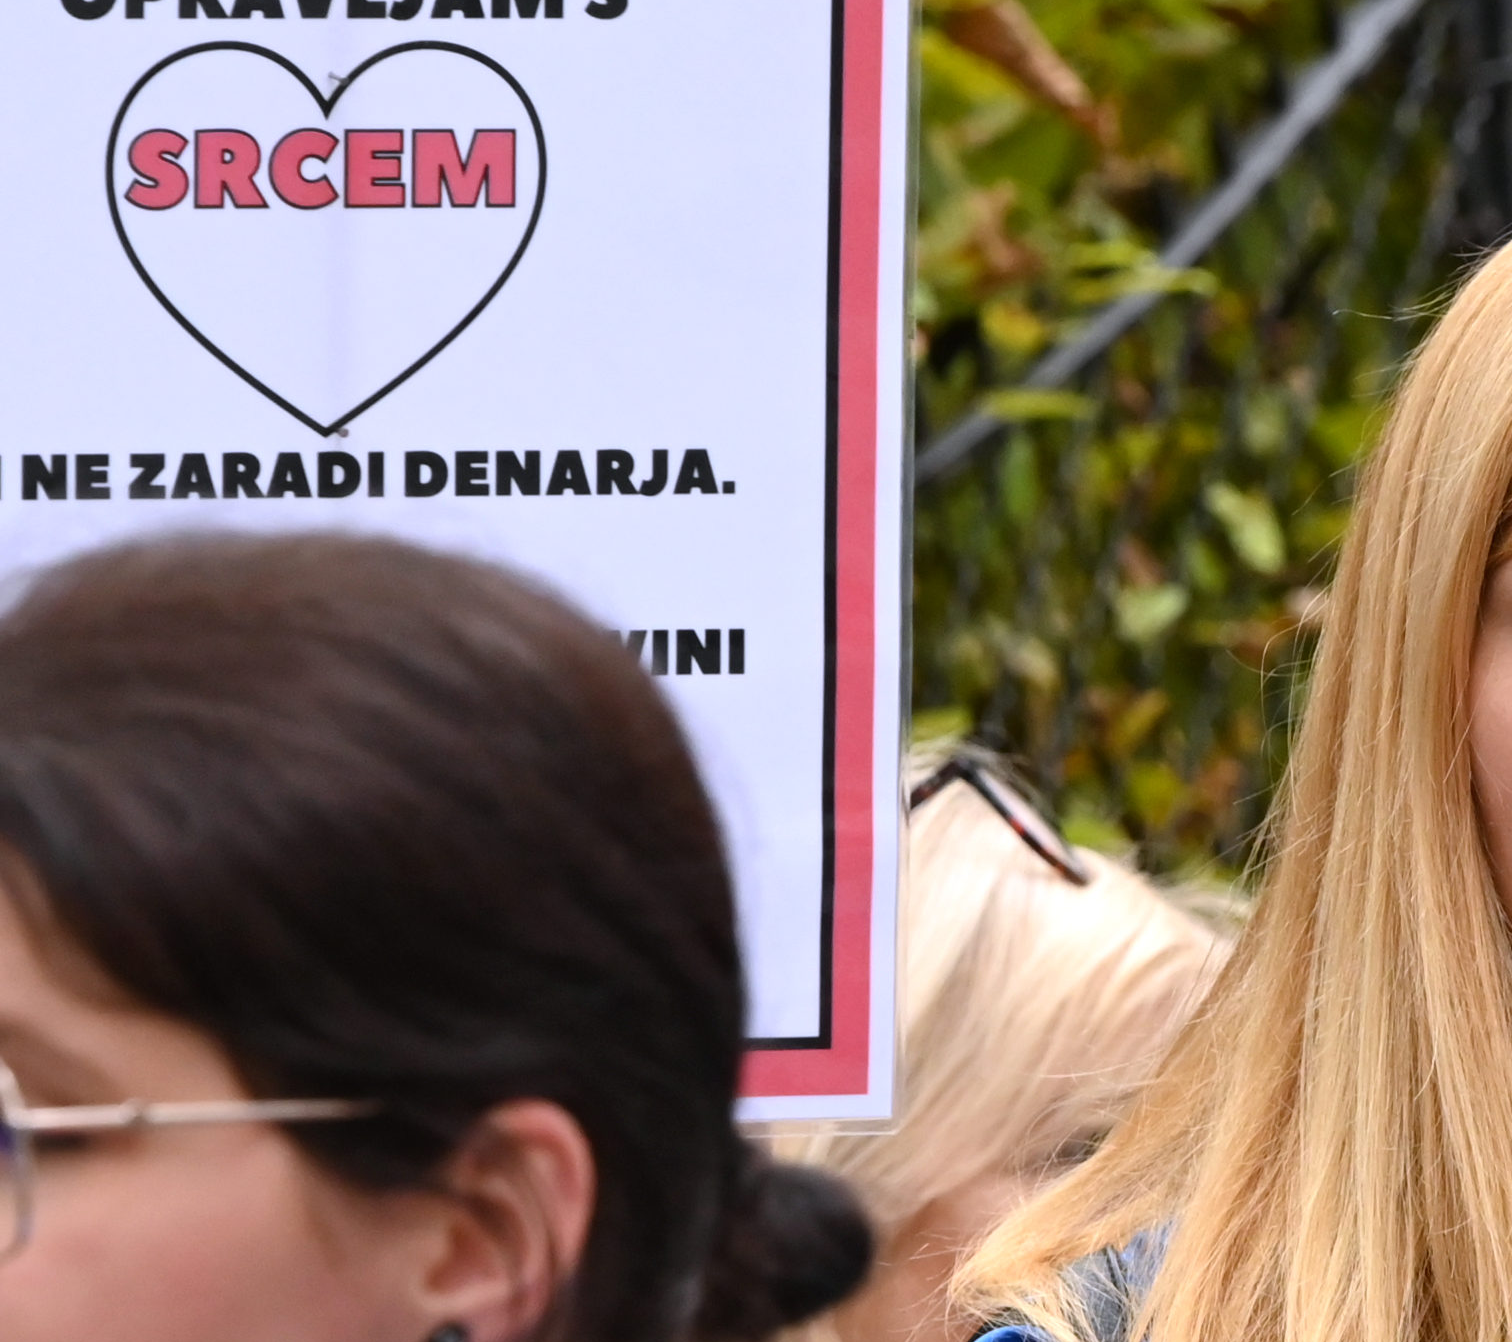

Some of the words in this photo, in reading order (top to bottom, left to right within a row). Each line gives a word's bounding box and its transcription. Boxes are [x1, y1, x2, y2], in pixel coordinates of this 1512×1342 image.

[123, 126, 518, 211] SRCEM
[21, 453, 112, 501] NE
[128, 451, 386, 501] ZARADI
[404, 448, 738, 498] DENARJA.
